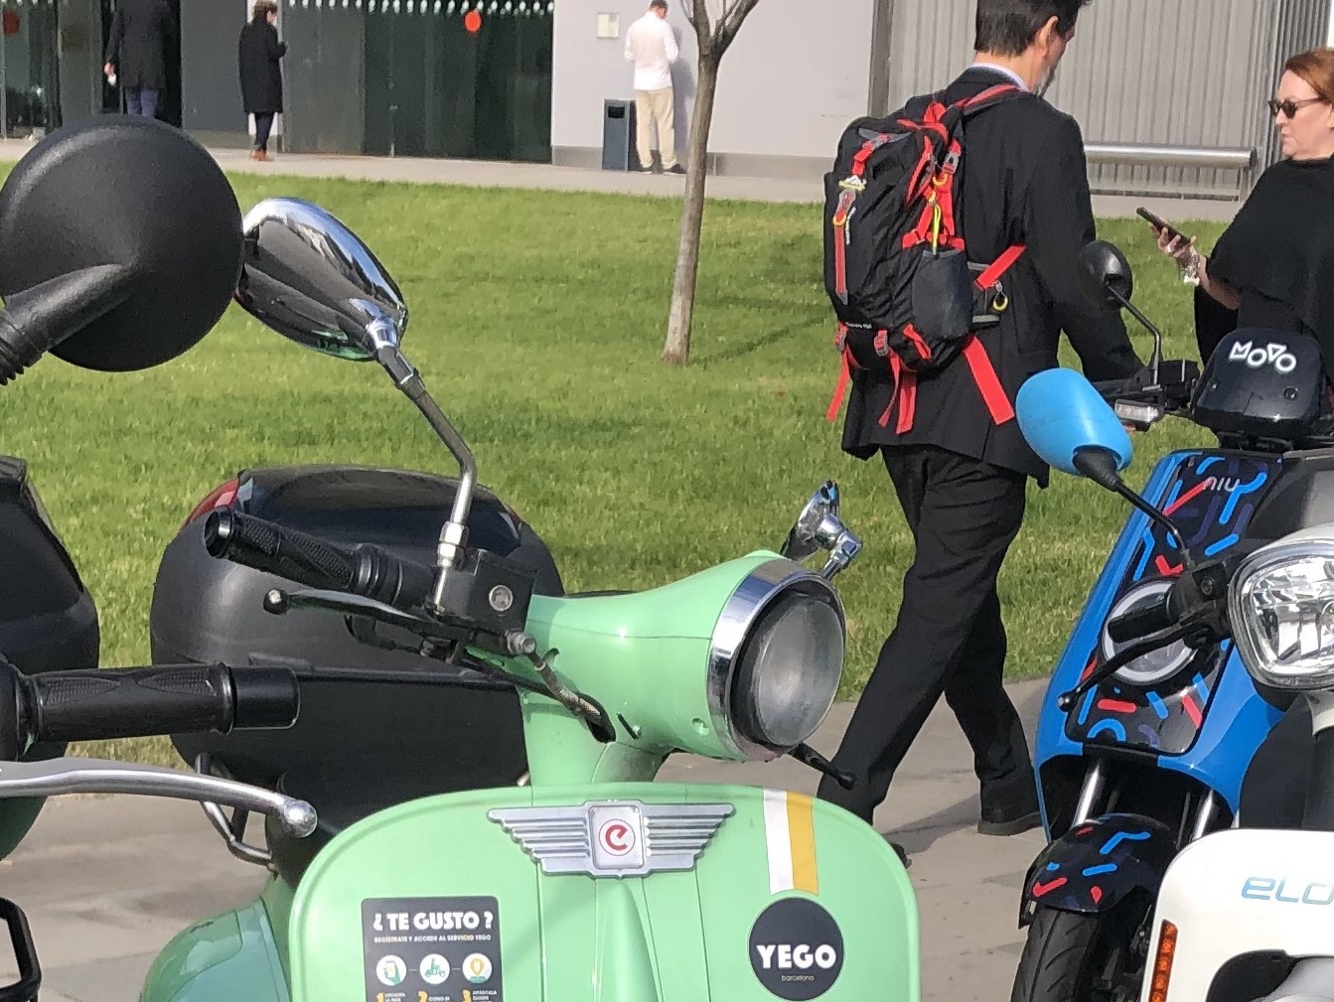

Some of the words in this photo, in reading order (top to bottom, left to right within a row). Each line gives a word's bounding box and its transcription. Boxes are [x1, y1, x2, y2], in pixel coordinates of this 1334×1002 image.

[1229, 341, 1297, 373] MOVO
[387, 912, 409, 931] TE
[413, 911, 480, 930] GUSTO
[756, 944, 836, 969] YEGO
